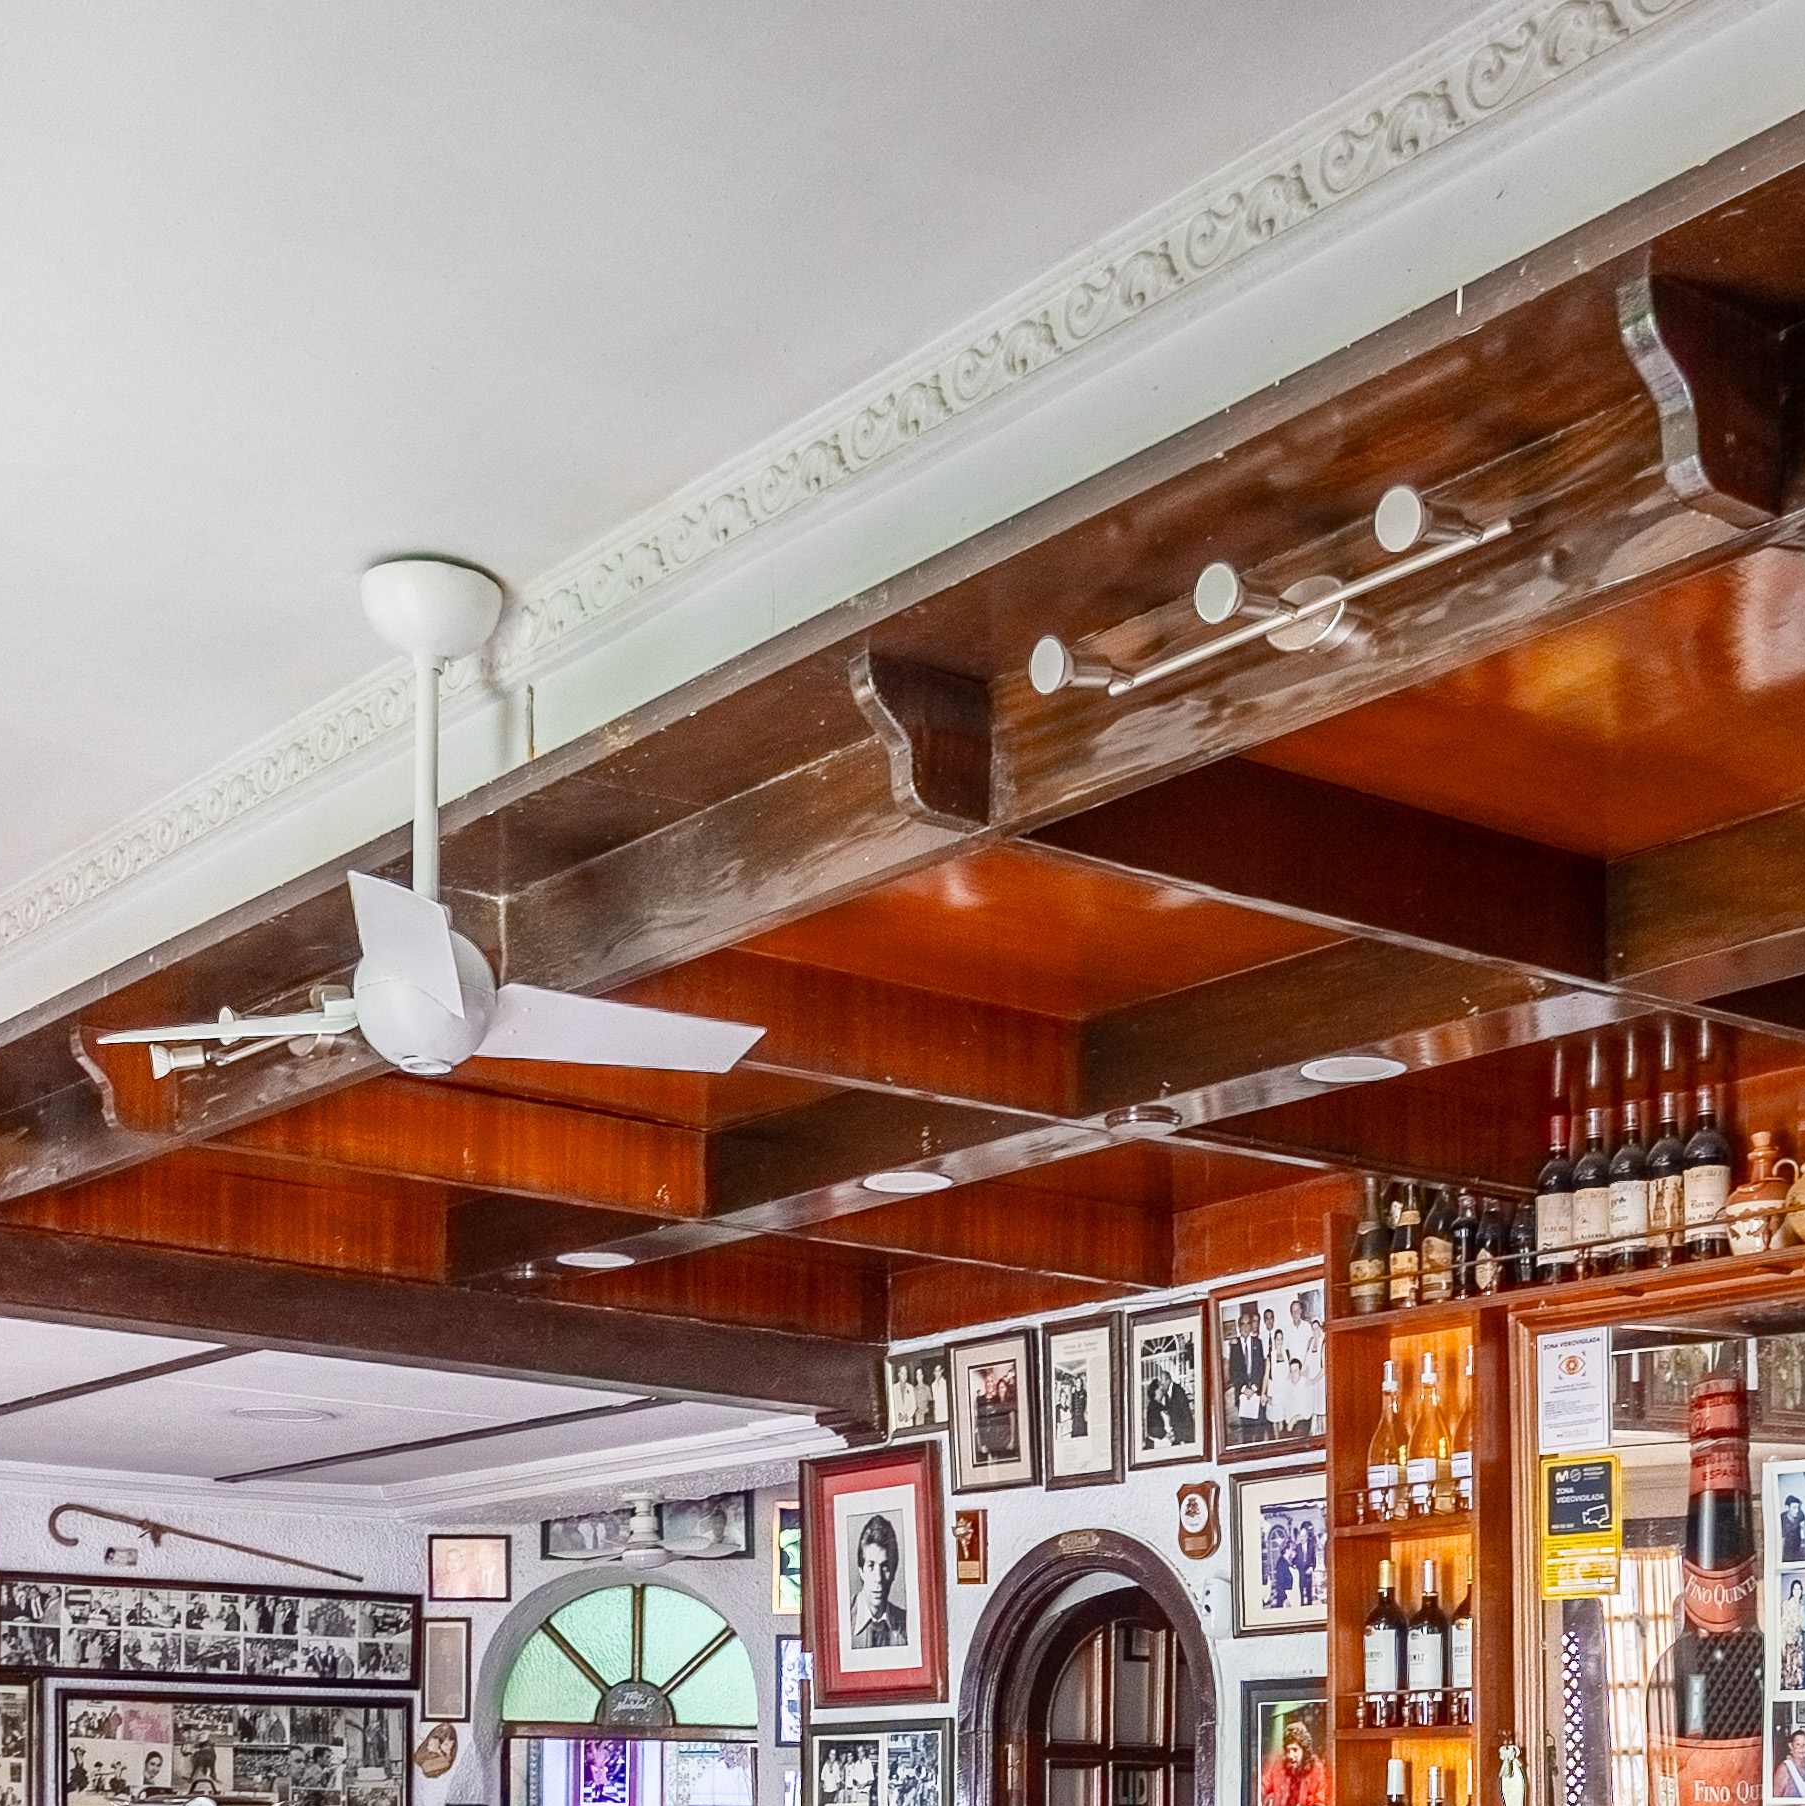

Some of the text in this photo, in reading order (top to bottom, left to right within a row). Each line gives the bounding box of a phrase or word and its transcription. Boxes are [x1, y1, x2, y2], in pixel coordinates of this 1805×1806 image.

[1544, 1342, 1557, 1351] ZONA
[1555, 1486, 1575, 1496] ZONA
[1555, 1493, 1606, 1506] VIDEOVIGILADA
[1685, 1574, 1712, 1605] FINO
[1694, 1779, 1763, 1804] FINO QU
